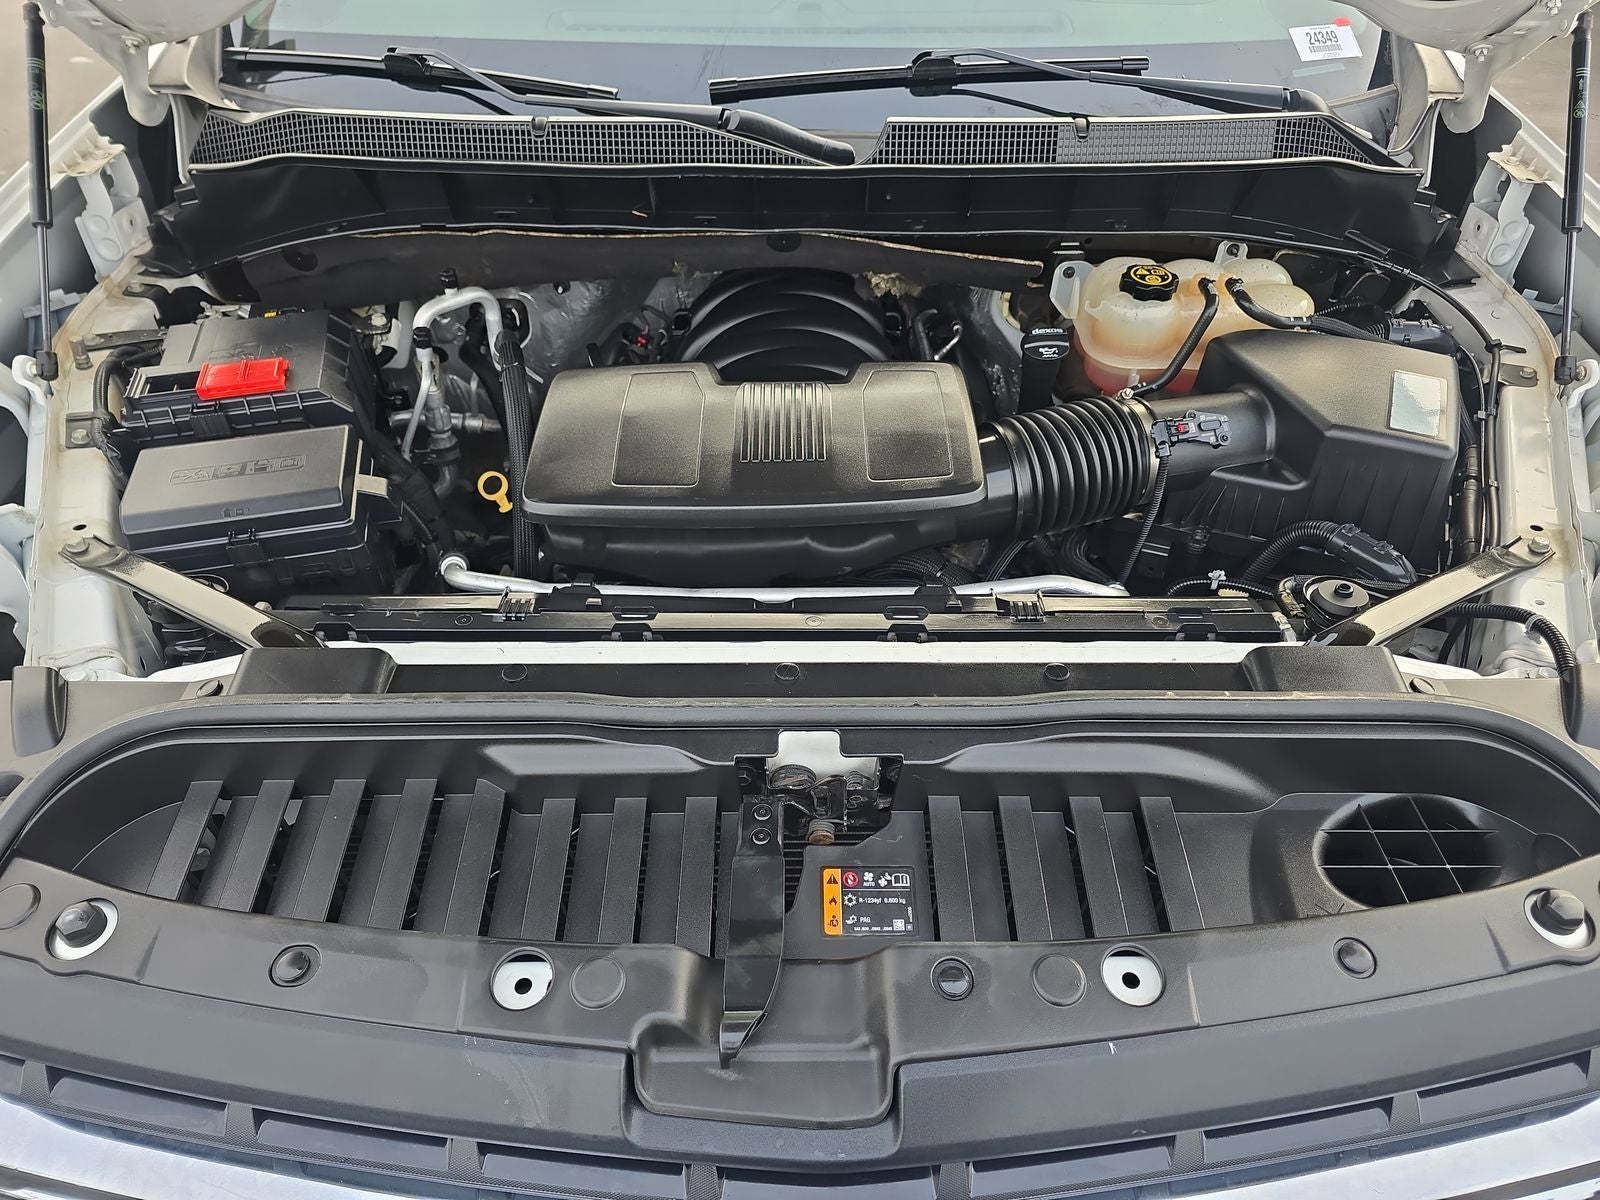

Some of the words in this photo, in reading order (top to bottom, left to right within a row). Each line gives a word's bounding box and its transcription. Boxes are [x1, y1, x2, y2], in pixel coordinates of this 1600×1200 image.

[1305, 30, 1339, 45] 24349
[858, 897, 882, 905] R-1234yf
[899, 897, 906, 905] kg
